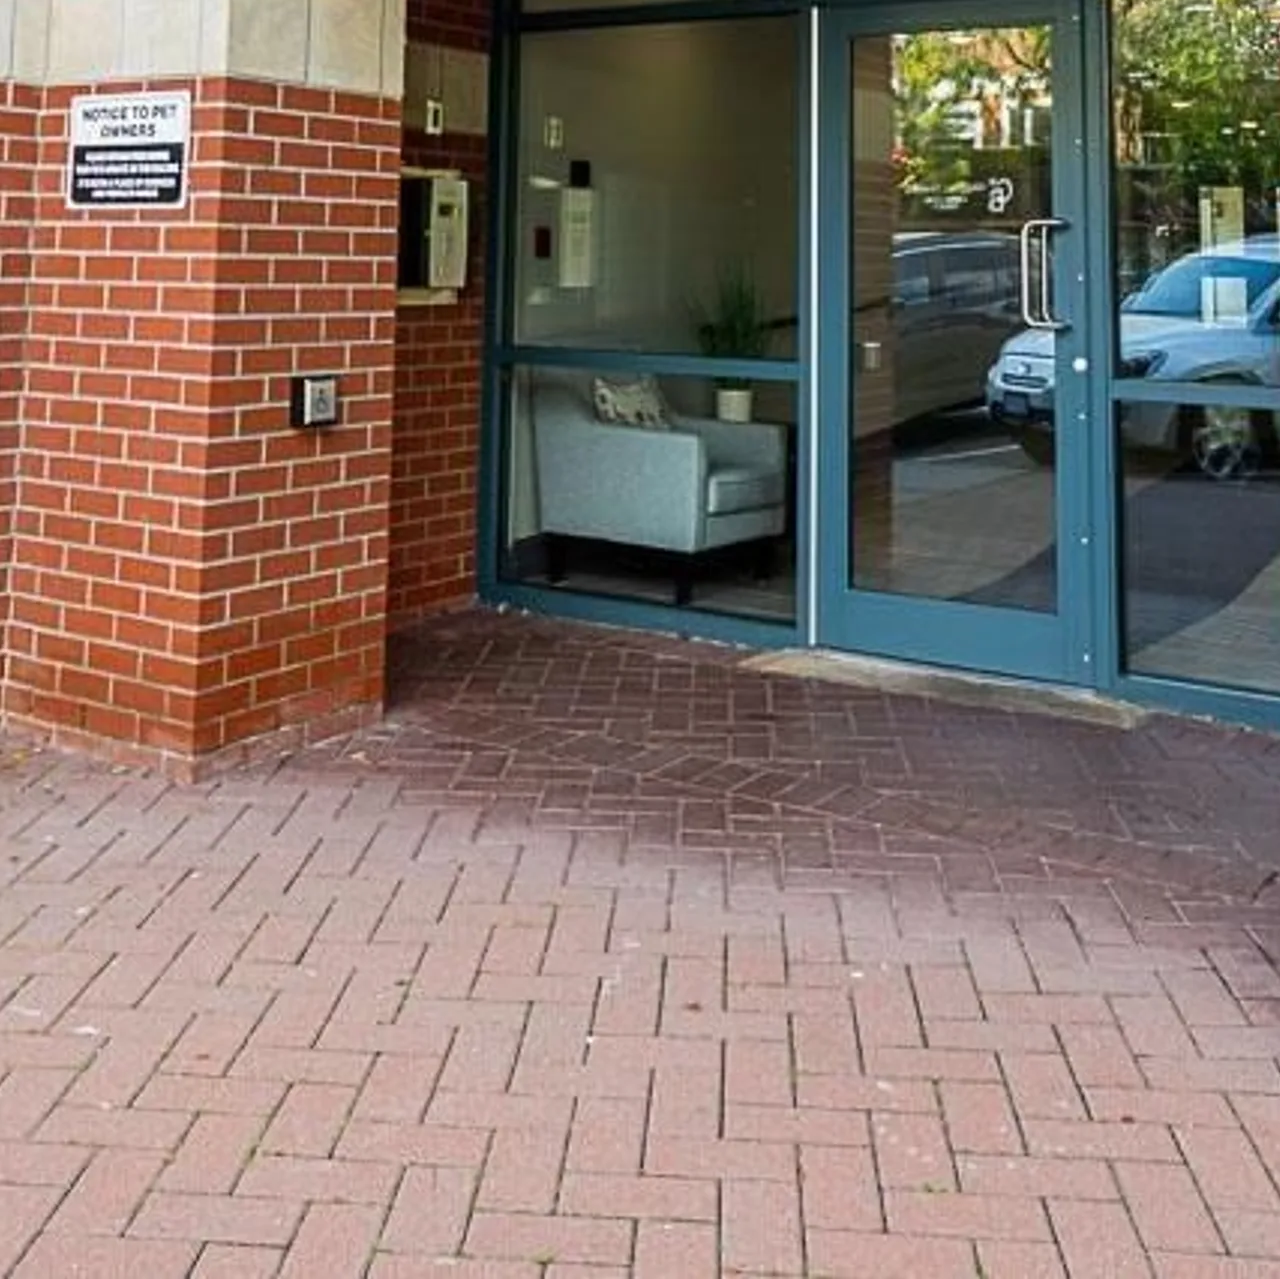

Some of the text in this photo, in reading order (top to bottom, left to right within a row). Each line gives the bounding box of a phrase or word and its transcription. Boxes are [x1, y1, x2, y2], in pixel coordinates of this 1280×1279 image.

[81, 103, 177, 122] NOTICE TO PET
[100, 123, 157, 138] OWNERS
